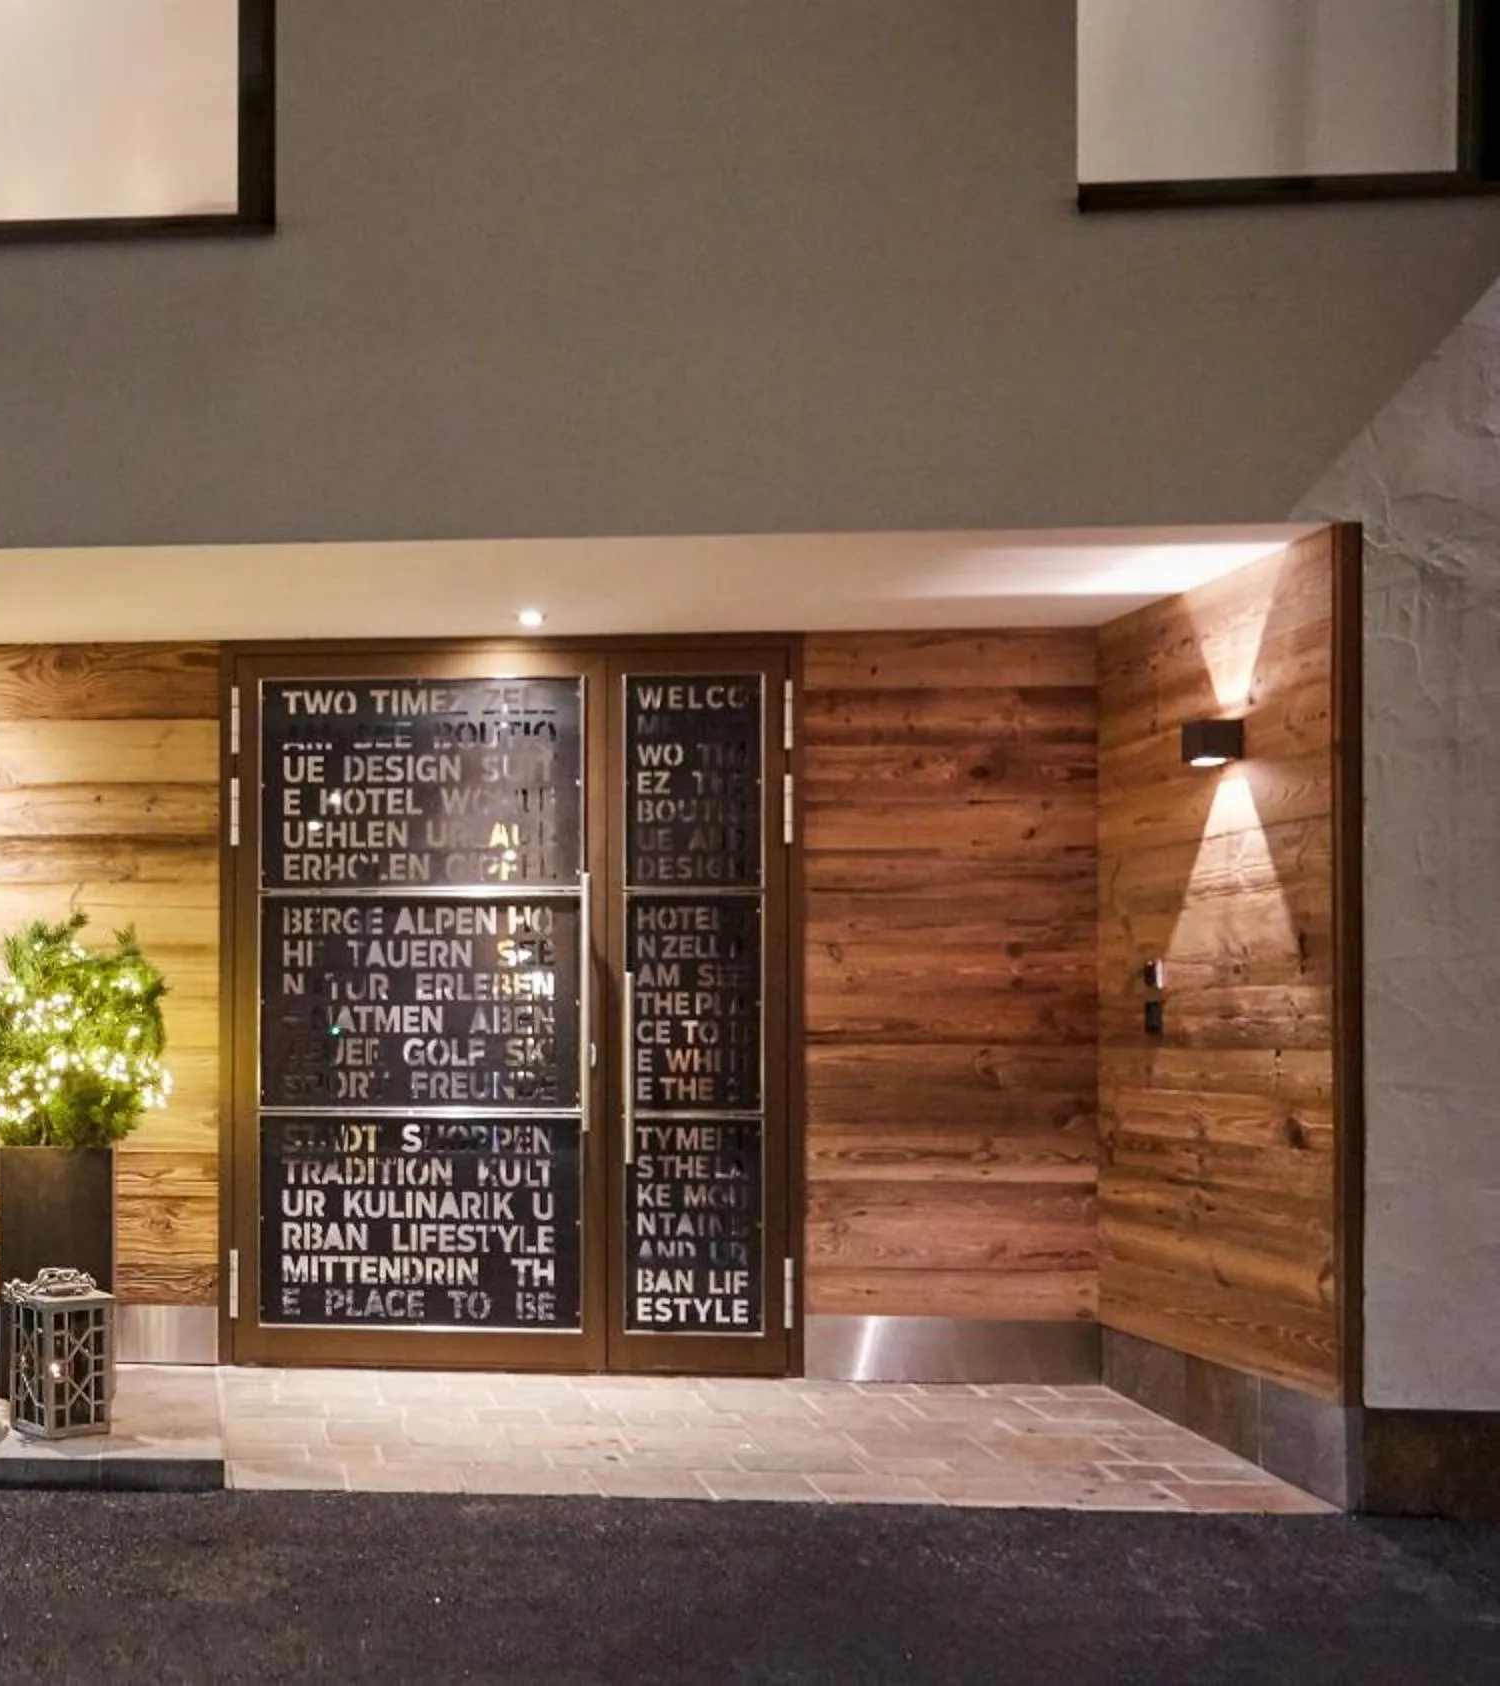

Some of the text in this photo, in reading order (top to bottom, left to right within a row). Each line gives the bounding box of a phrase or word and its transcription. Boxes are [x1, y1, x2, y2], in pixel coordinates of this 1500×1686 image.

[282, 689, 357, 716] TWO
[282, 755, 325, 783] UE
[343, 754, 461, 783] DESIGN
[636, 742, 685, 767] WO
[636, 770, 672, 795] EZ
[282, 788, 302, 816] E
[318, 788, 423, 816] HOTEL
[282, 820, 409, 848] UEHLEN
[282, 906, 384, 935] BERGE
[393, 906, 498, 935] ALPEN
[346, 939, 474, 968] TAUERN
[637, 934, 656, 959] N
[282, 972, 556, 1001] NTUR ERLEBEN
[637, 962, 681, 988] AM
[637, 991, 690, 1016] THE
[636, 1019, 672, 1044] CE
[681, 1019, 720, 1044] TO
[402, 1037, 487, 1067] GOLF
[637, 1048, 653, 1073] E
[411, 1070, 558, 1100] FREUNE
[637, 1076, 654, 1101] E
[658, 1076, 715, 1102] THE
[280, 1156, 554, 1188] TRADITION KULT
[657, 1155, 710, 1179] THE
[281, 1189, 556, 1220] UR KULINARIK U
[636, 1183, 672, 1208] KE
[281, 1221, 556, 1255] RBAN LIFESTYLE
[281, 1254, 556, 1288] MITTENDRIN TH
[636, 1267, 749, 1295] BAN LIF
[281, 1286, 556, 1321] E PLACE TO BE
[636, 1297, 749, 1324] ESTYLE
